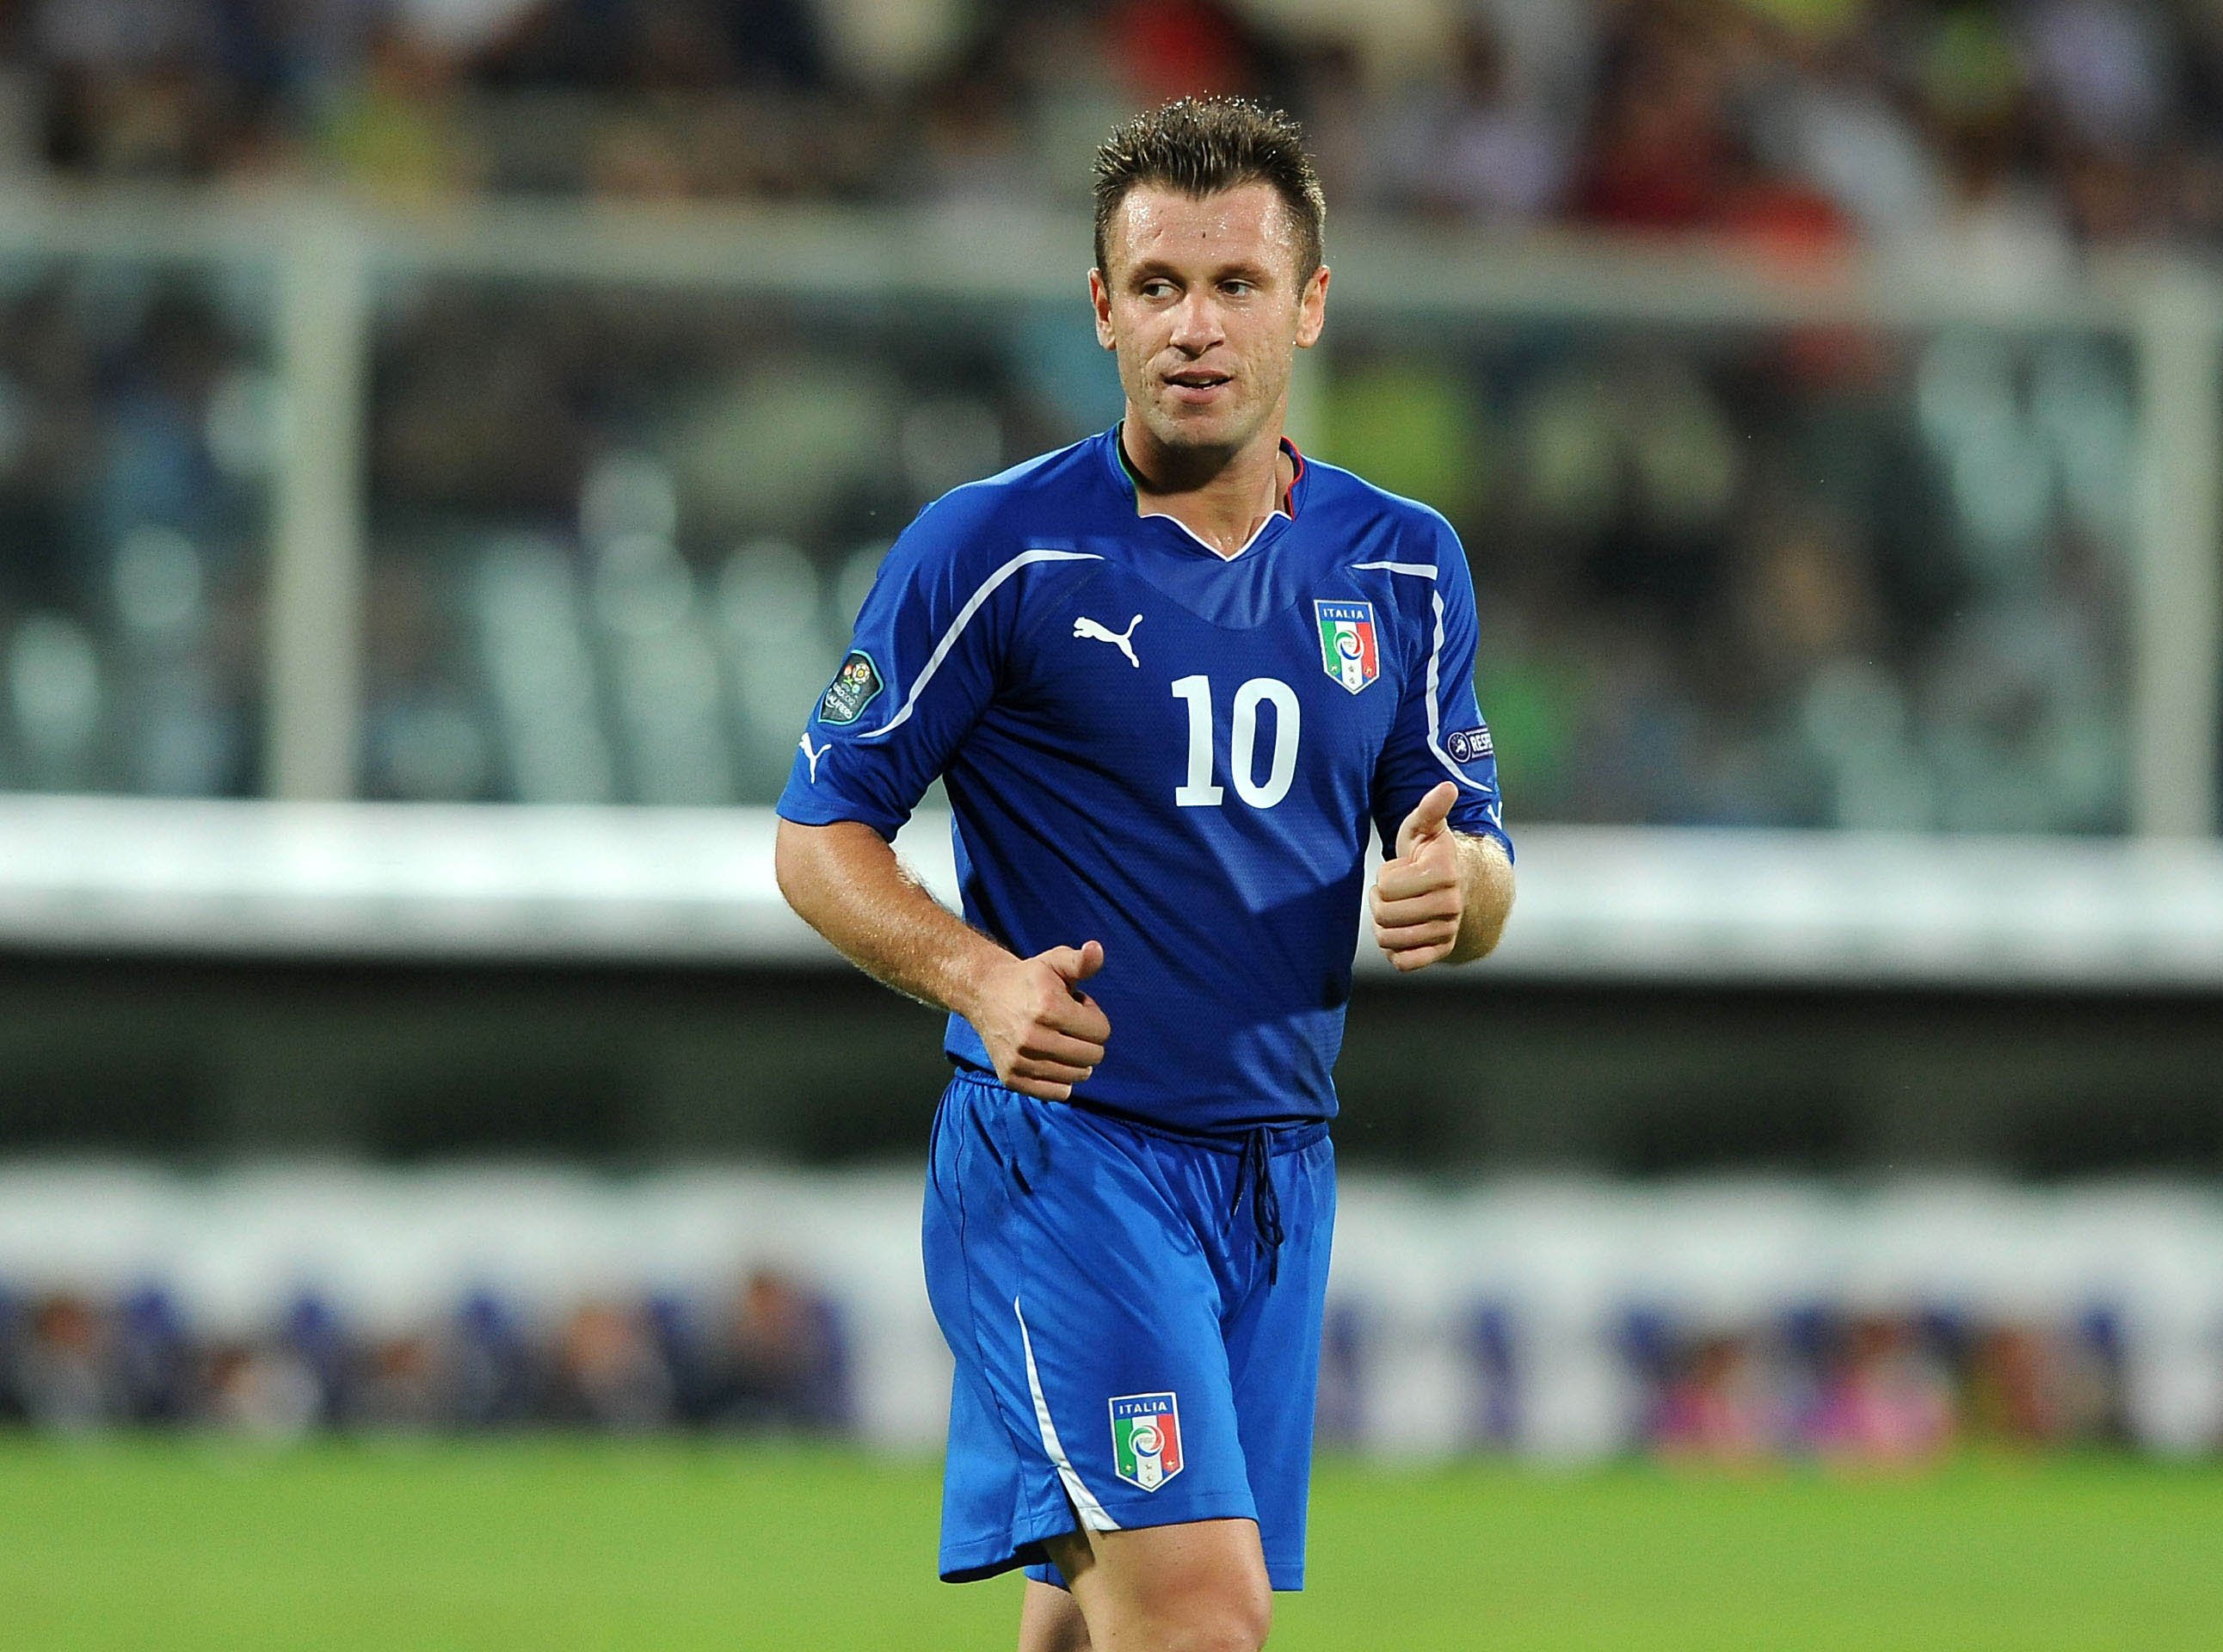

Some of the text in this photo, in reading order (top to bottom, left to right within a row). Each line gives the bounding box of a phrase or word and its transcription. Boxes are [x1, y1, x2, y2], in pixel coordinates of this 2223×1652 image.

[1323, 608, 1364, 620] ITALIA
[1171, 675, 1300, 809] 10
[1119, 1402, 1167, 1415] ITALIA
